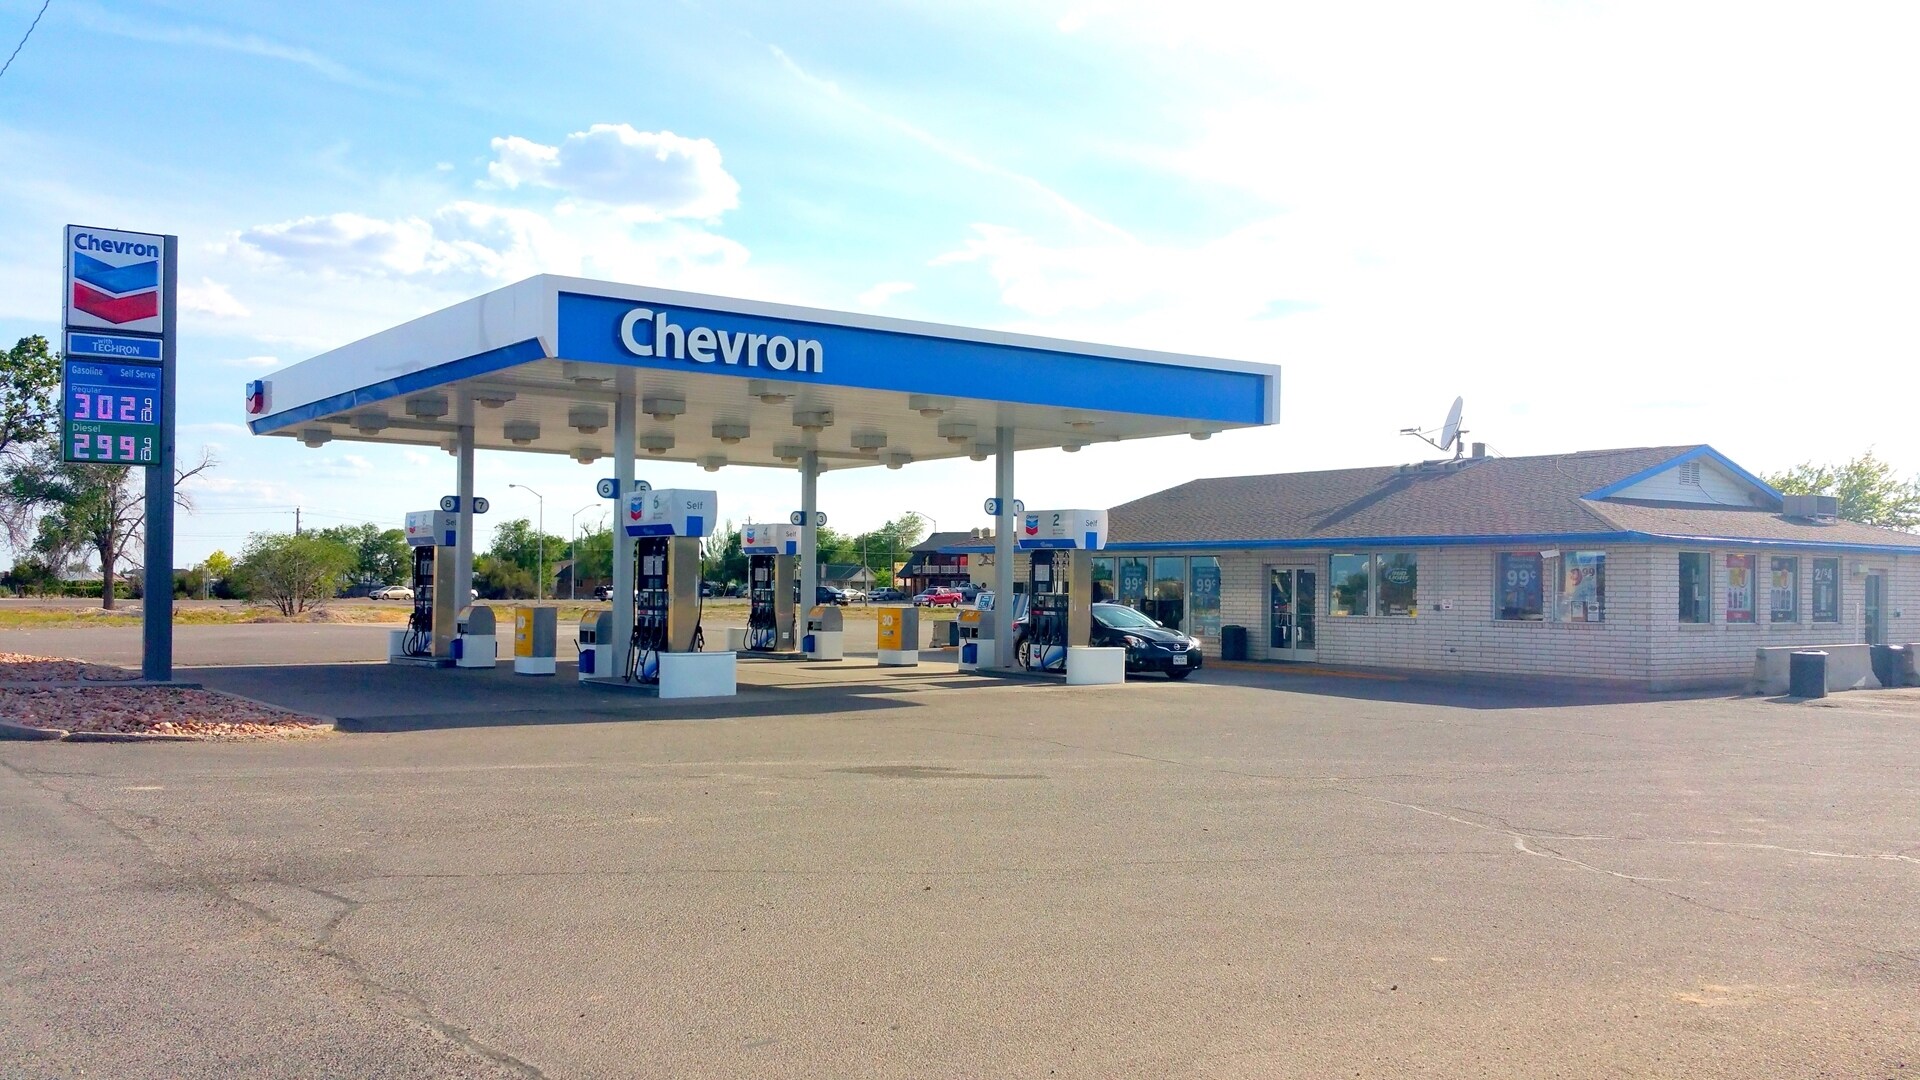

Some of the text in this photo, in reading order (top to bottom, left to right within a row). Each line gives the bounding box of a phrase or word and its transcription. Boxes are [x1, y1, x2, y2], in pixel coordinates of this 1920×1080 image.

[74, 233, 159, 258] Chevron
[621, 308, 824, 373] Chevron
[92, 342, 141, 355] TECHRON
[71, 365, 156, 379] Gasoline Self Serve
[71, 386, 102, 394] Regular
[74, 393, 136, 421] 302
[72, 423, 101, 433] Diesel
[74, 433, 136, 460] 299
[602, 484, 610, 493] 6
[445, 500, 452, 508] 8
[686, 500, 704, 510] Self
[988, 503, 994, 511] 2
[1053, 513, 1060, 527] 2
